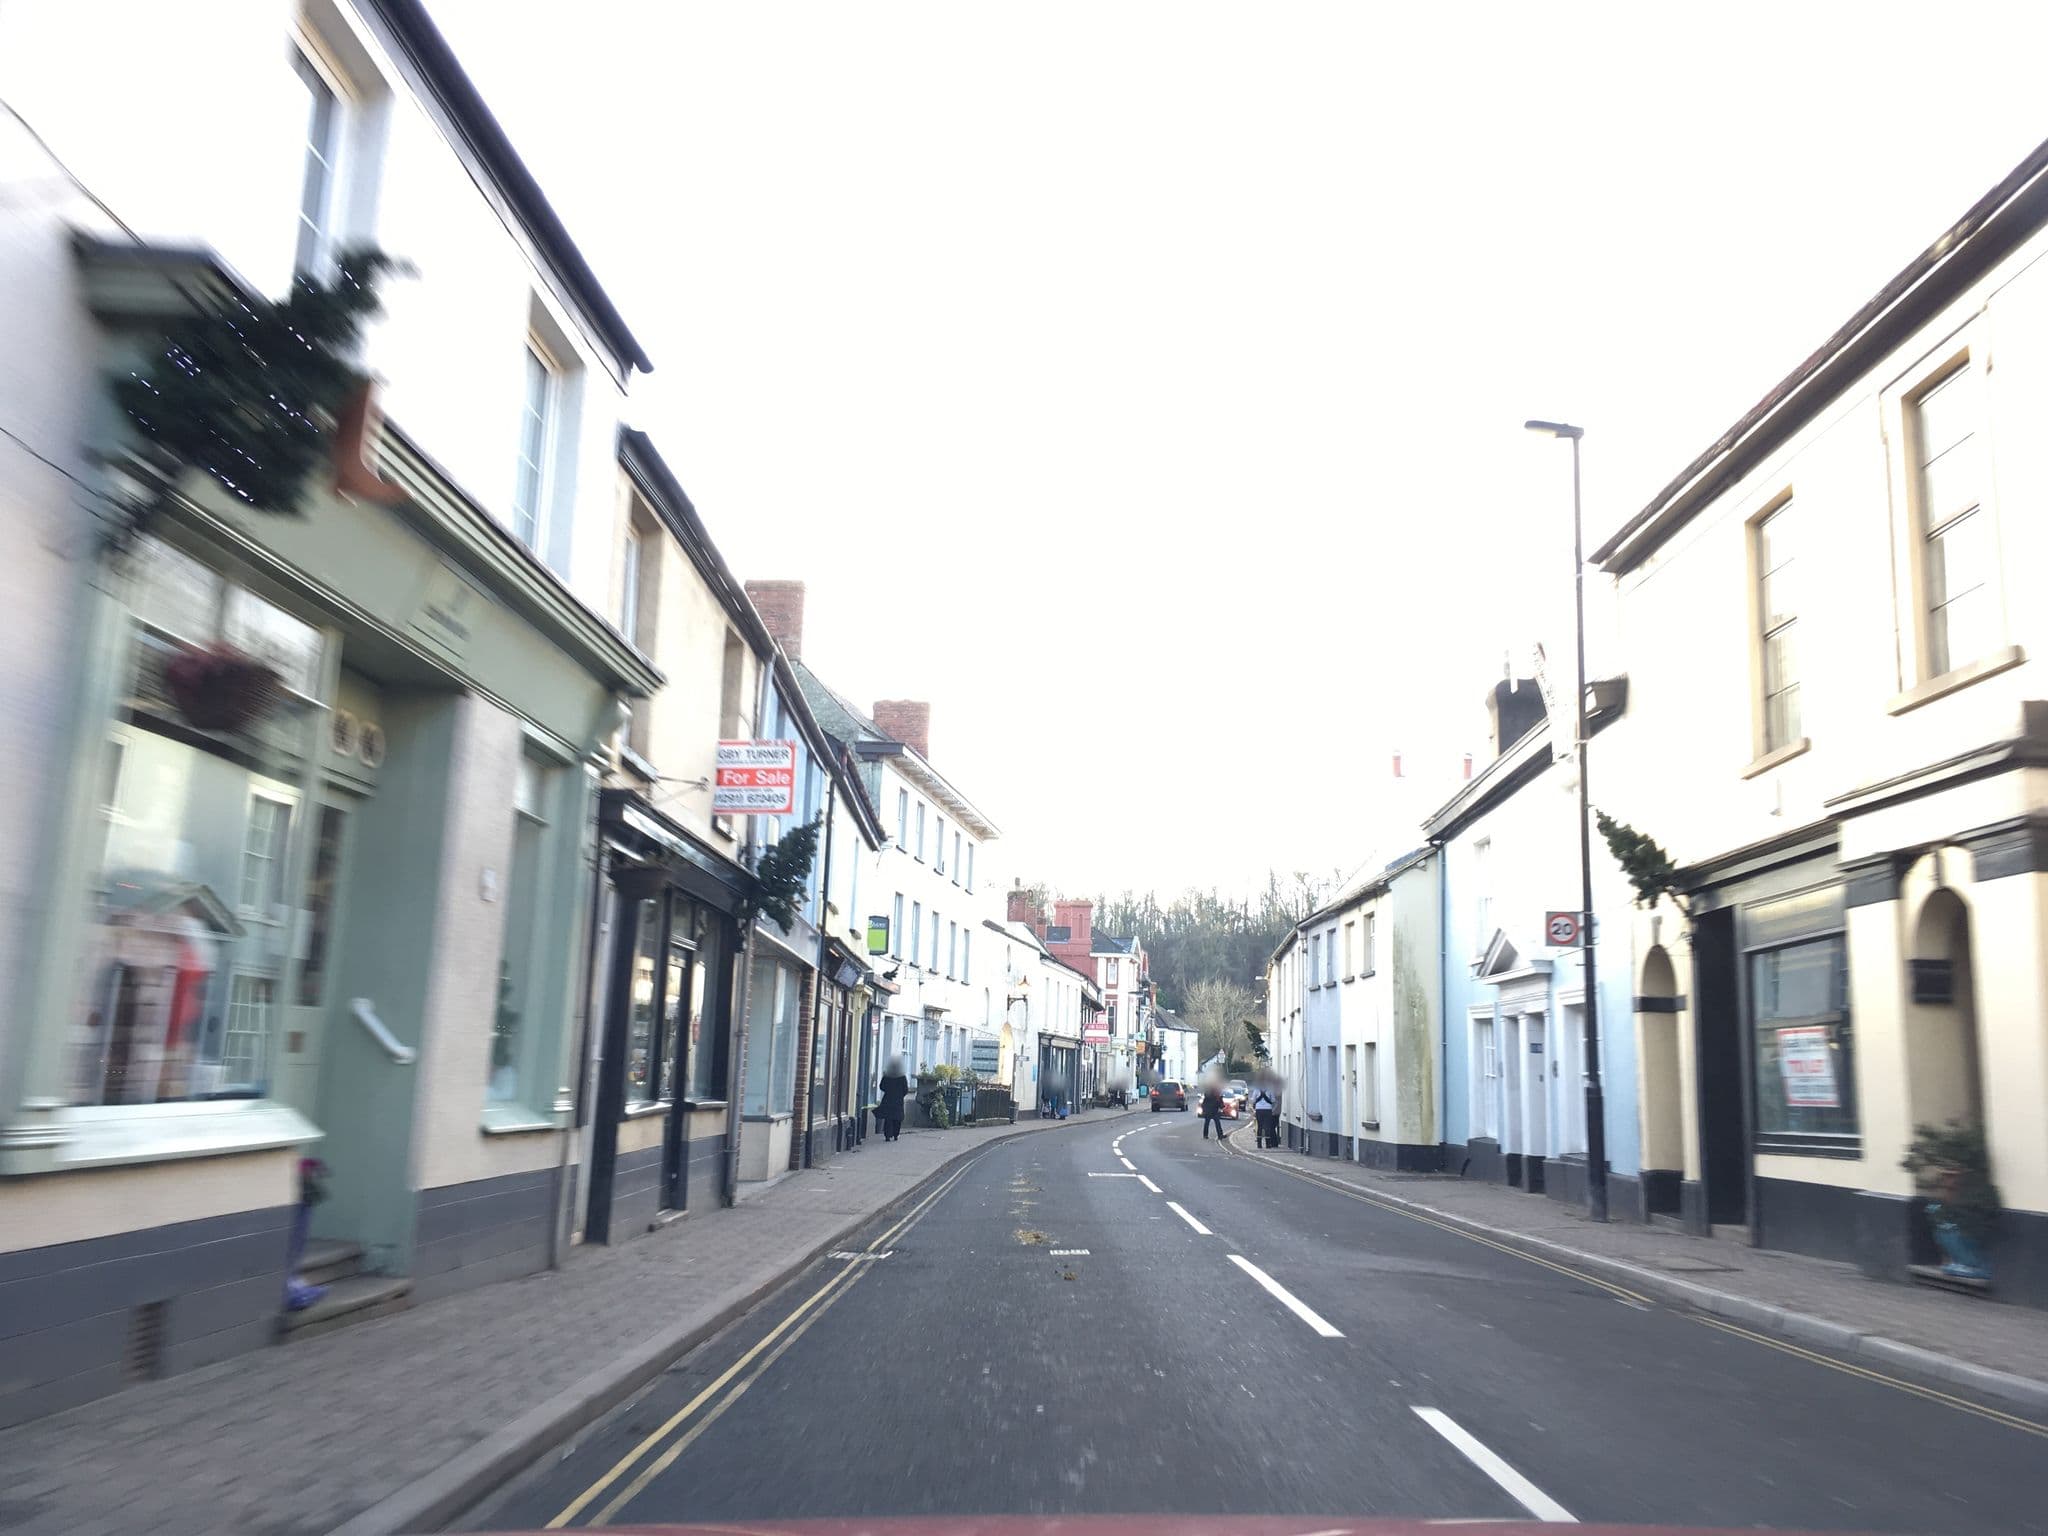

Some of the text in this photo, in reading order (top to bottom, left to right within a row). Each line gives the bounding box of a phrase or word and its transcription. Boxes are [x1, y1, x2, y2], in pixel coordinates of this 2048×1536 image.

[746, 748, 790, 760] TURNER
[723, 769, 791, 785] For Sale
[1552, 922, 1573, 936] 20
